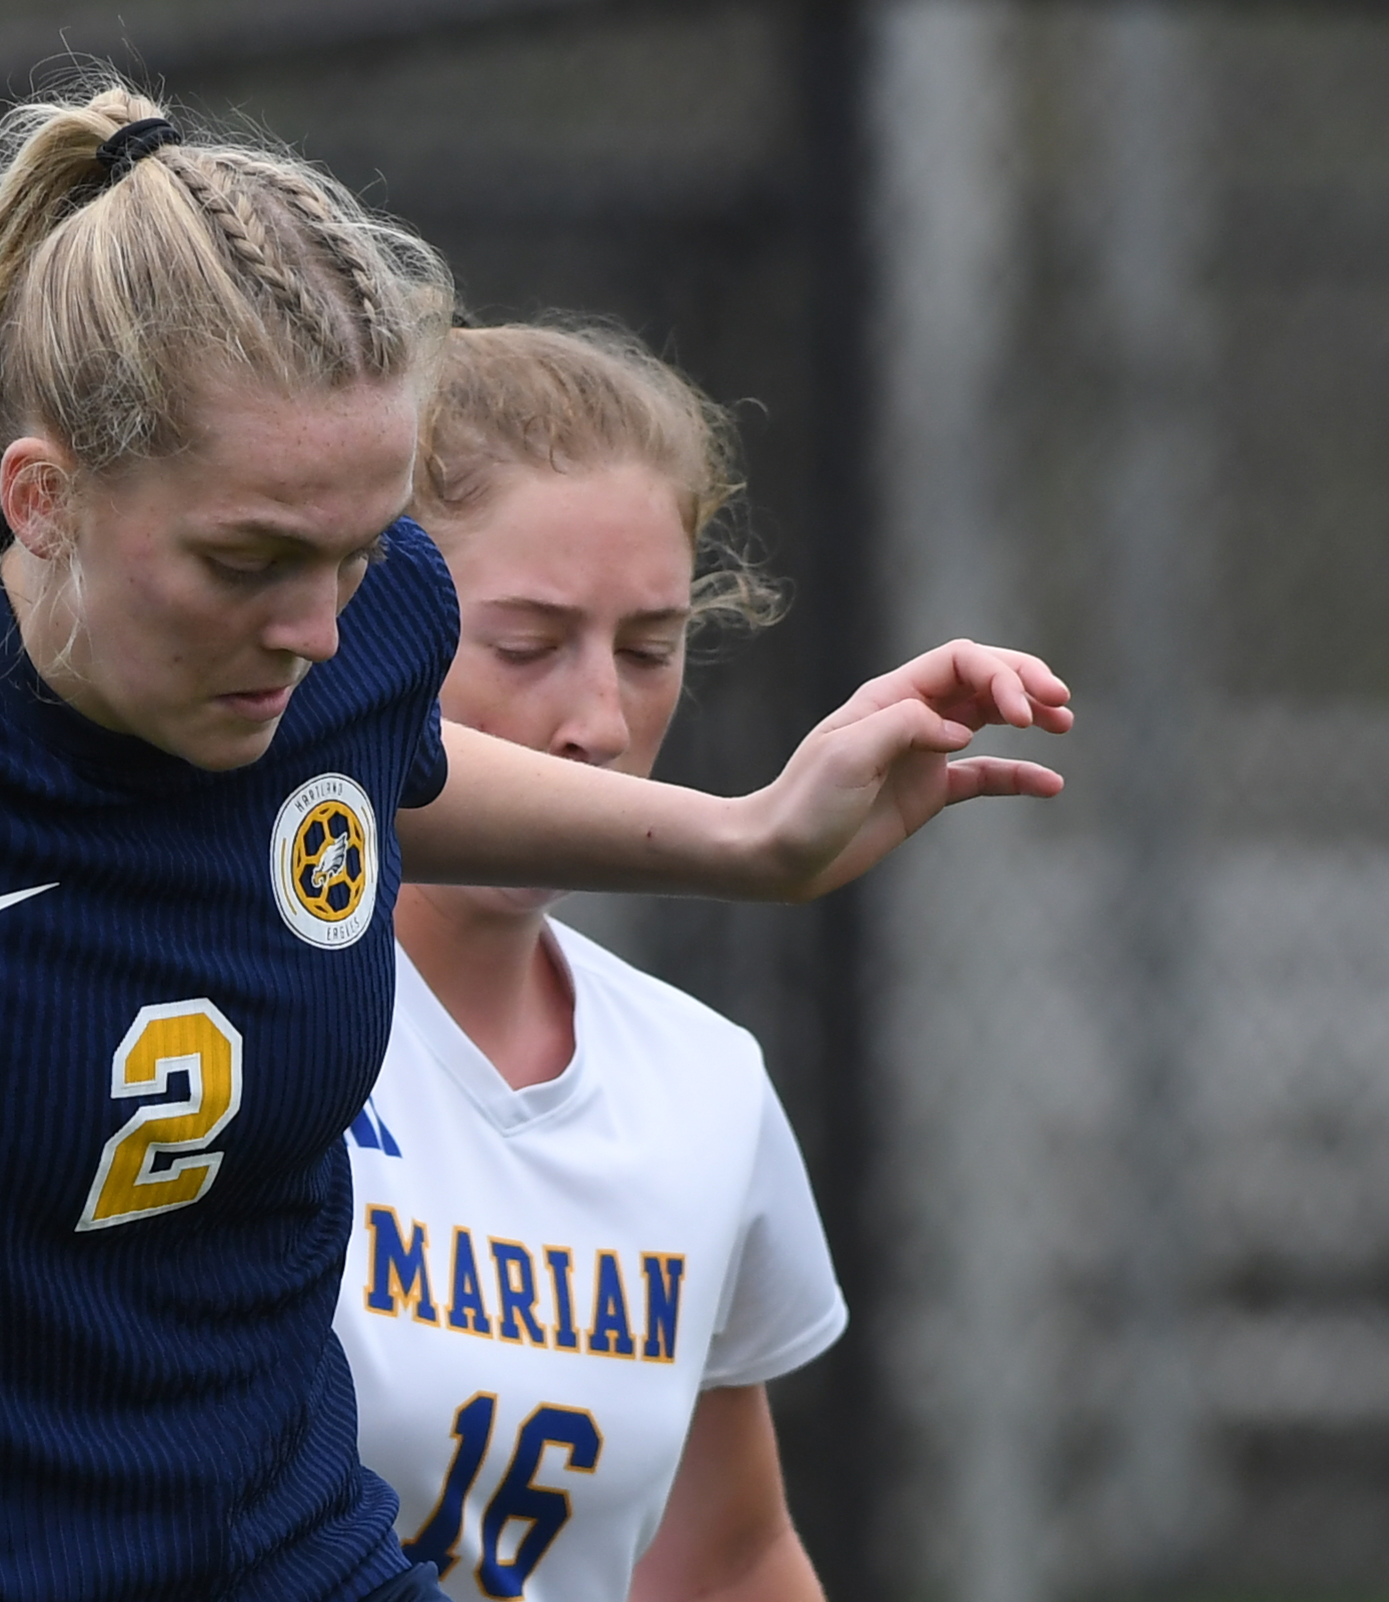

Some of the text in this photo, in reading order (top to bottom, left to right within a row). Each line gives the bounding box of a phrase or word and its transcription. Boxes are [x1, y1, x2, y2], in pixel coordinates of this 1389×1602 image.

[327, 916, 360, 941] EAGLES
[74, 997, 243, 1232] 2
[364, 1203, 685, 1364] MARIAN
[401, 1390, 604, 1602] 16
